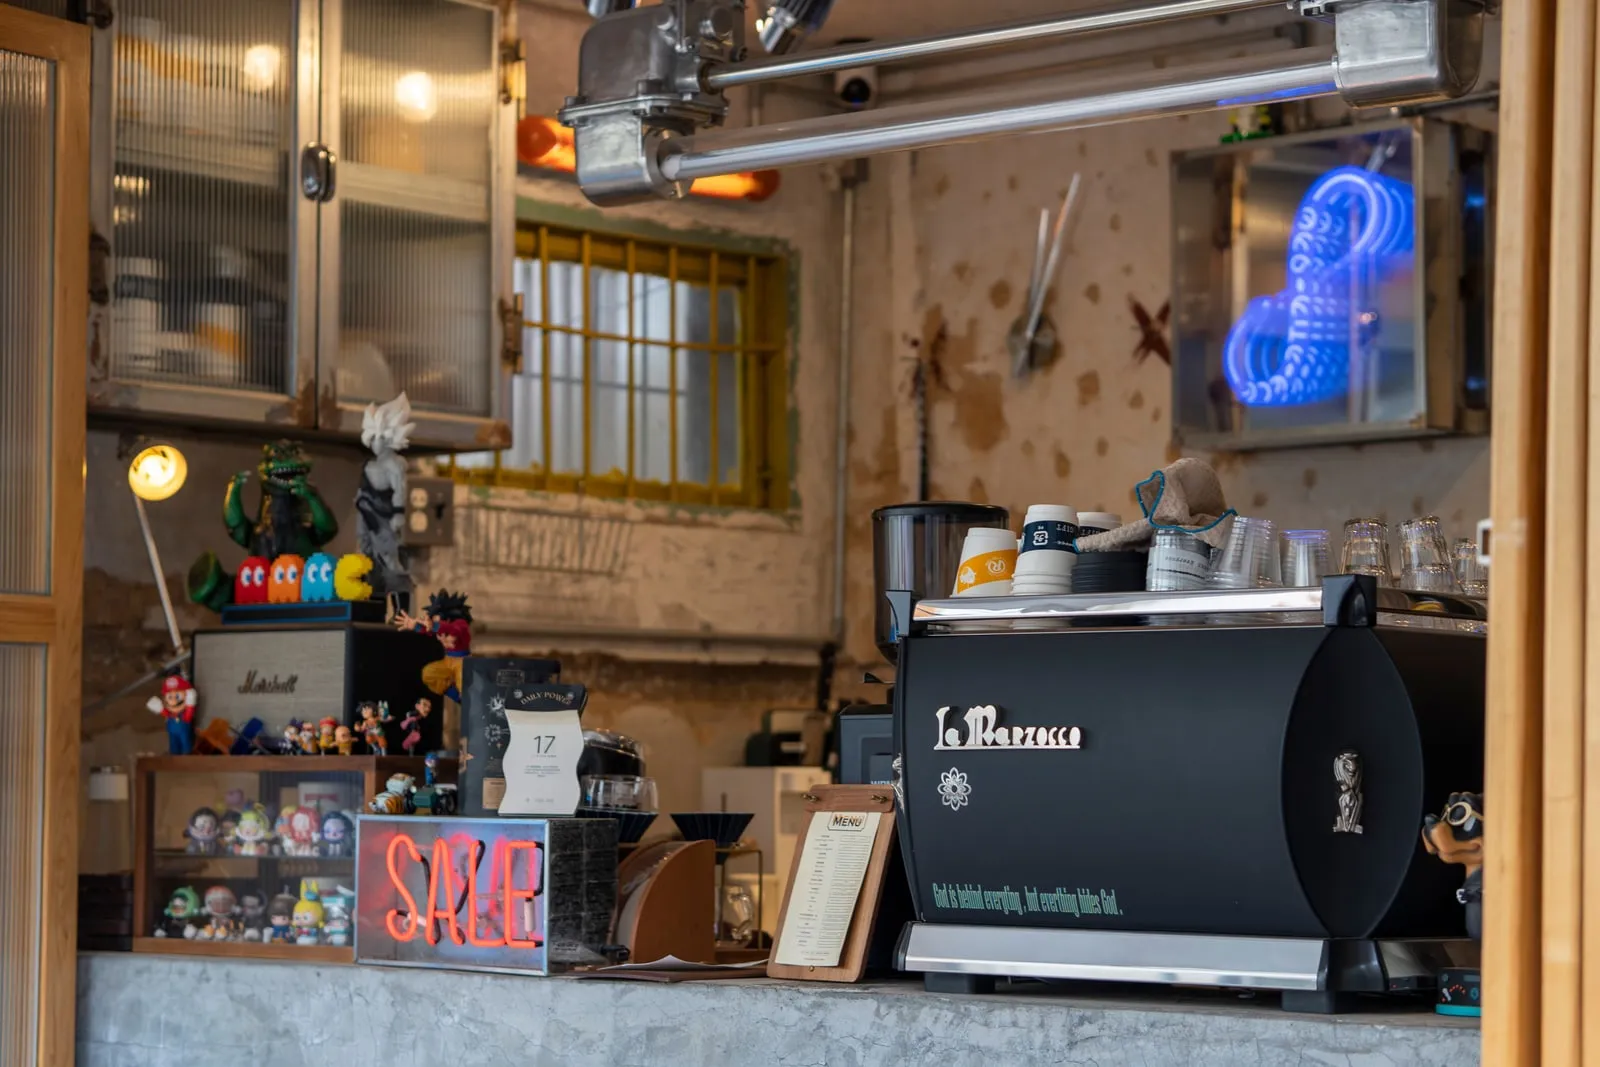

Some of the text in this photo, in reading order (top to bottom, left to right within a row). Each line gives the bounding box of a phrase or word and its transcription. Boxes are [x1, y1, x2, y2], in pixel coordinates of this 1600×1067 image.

[237, 669, 299, 695] Marshall
[520, 691, 573, 705] DAILY POWER
[934, 704, 1081, 750] La Marzocco
[533, 735, 556, 754] 17
[832, 815, 863, 827] MENU
[386, 834, 540, 948] SALE
[932, 882, 950, 908] God
[949, 884, 959, 909] is
[956, 883, 985, 910] behind
[1024, 886, 1041, 912] but
[1077, 888, 1101, 914] hides
